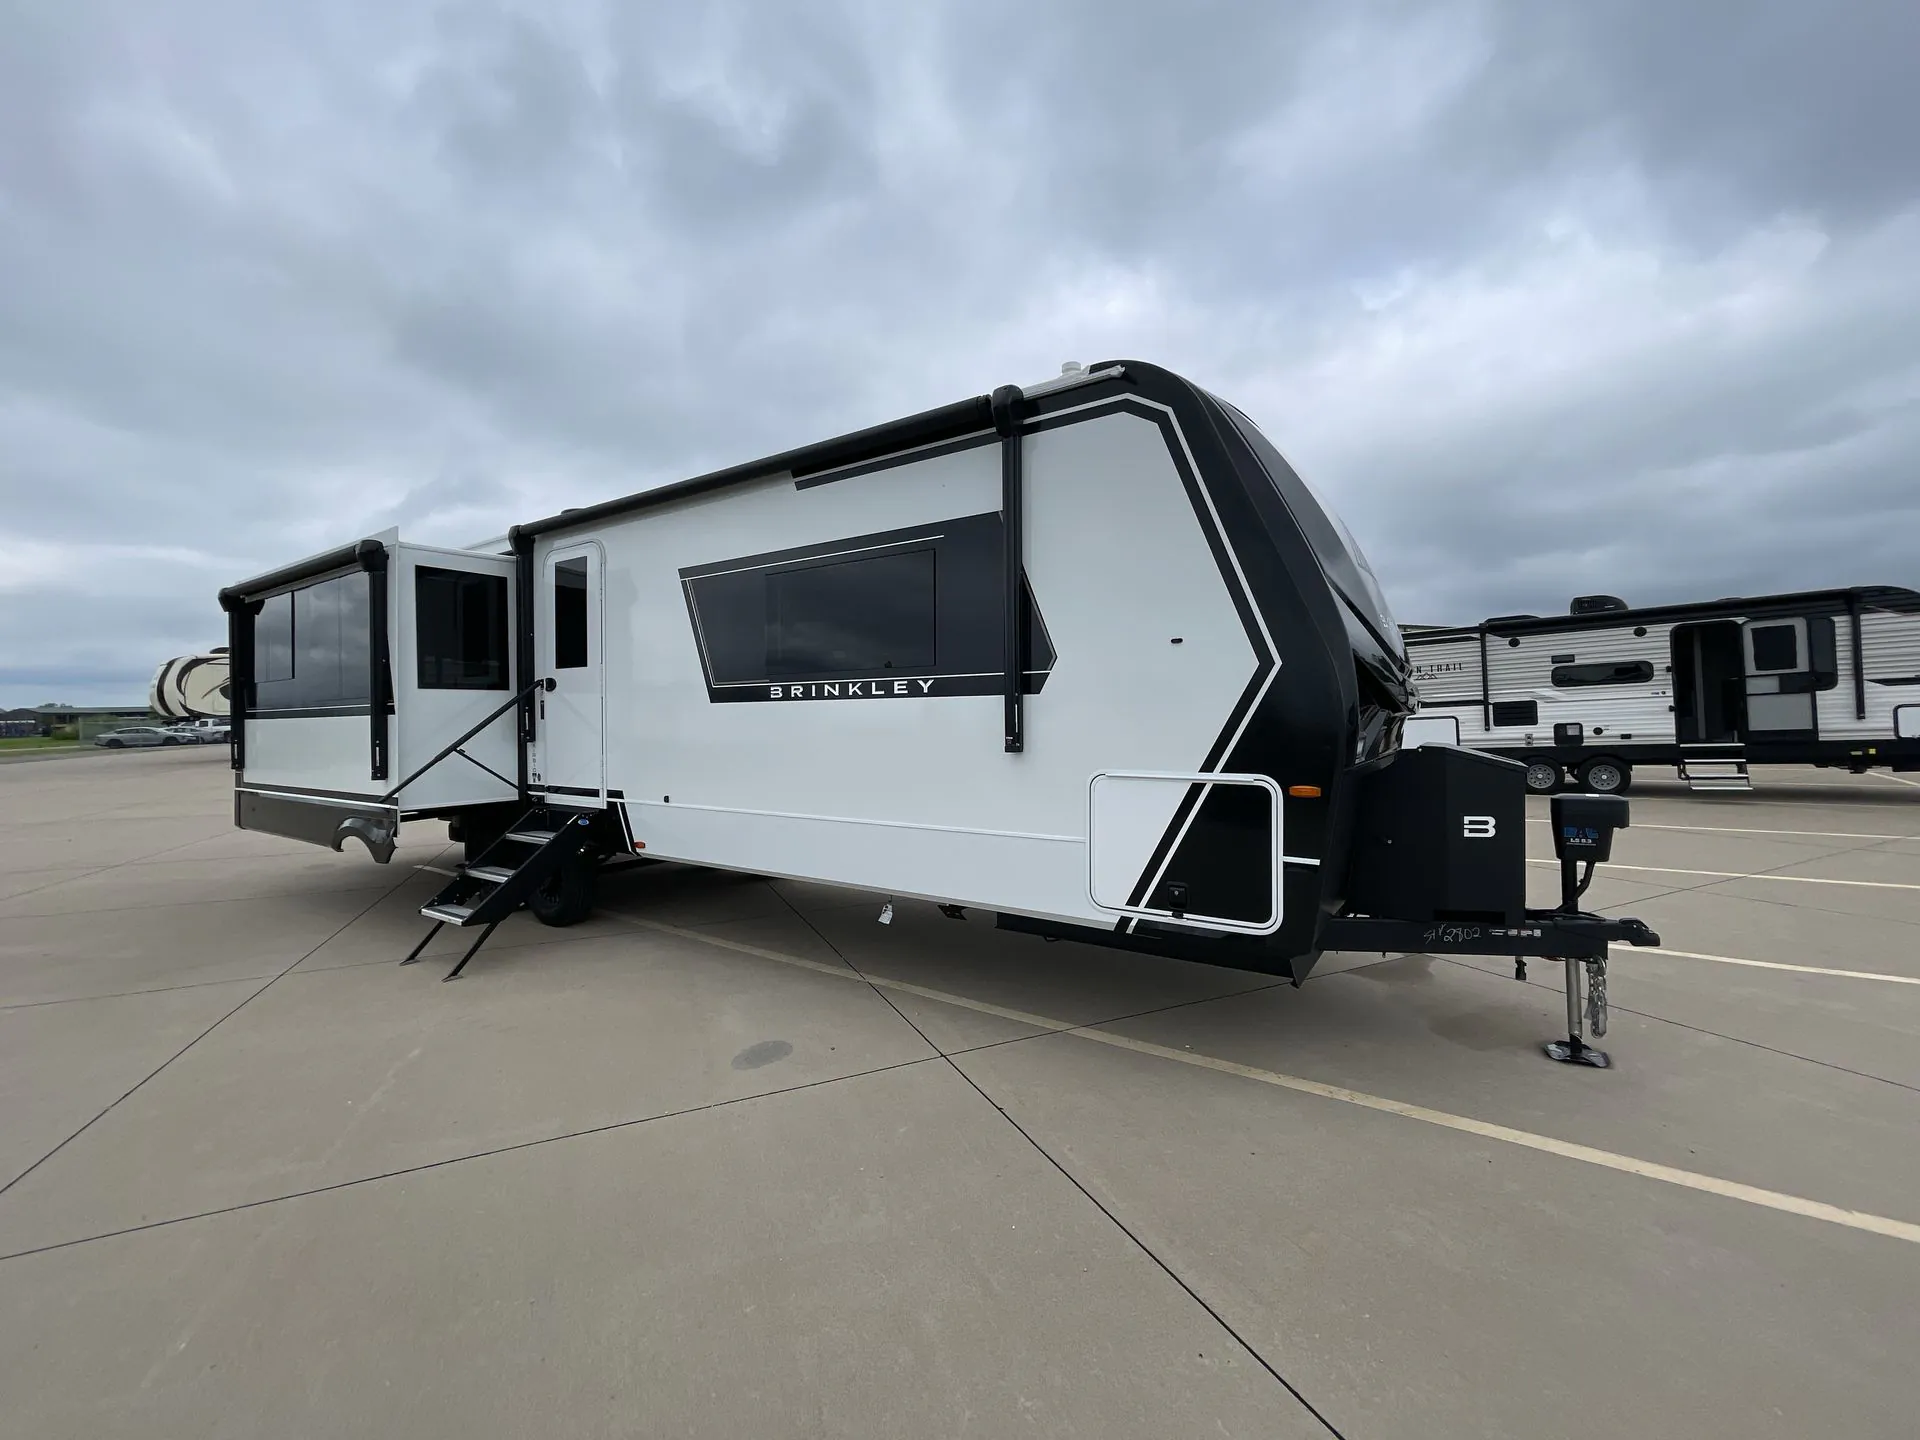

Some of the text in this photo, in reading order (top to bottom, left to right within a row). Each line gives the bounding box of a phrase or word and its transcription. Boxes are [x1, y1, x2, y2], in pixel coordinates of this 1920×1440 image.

[1430, 662, 1463, 673] TRAIL
[770, 679, 934, 699] BRINKLEY
[1463, 815, 1496, 838] B
